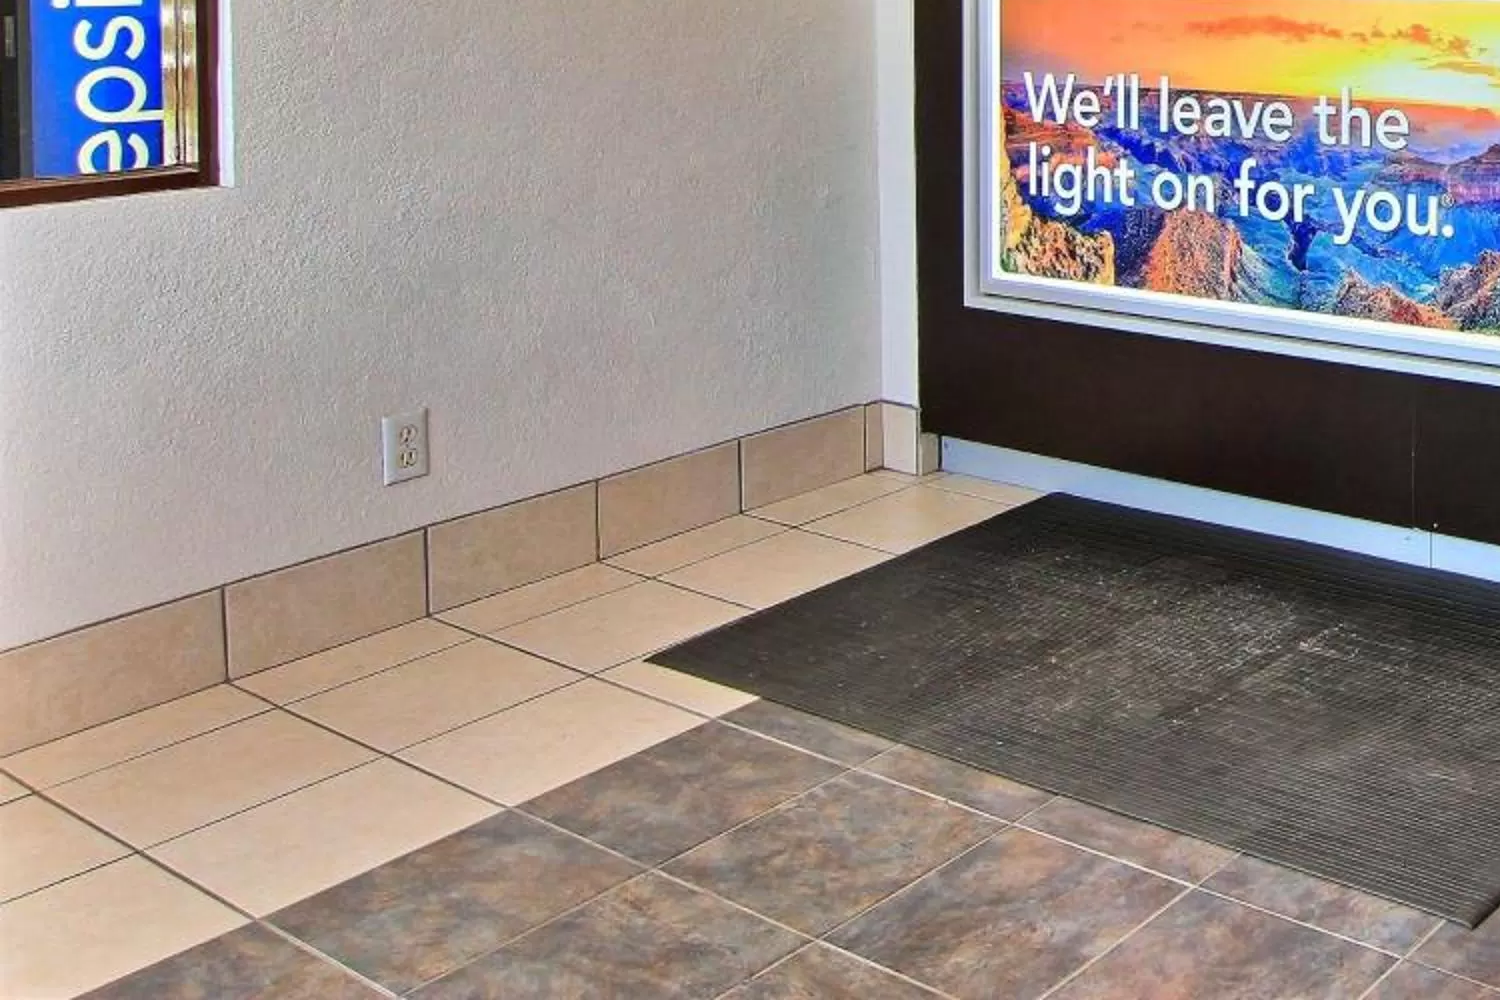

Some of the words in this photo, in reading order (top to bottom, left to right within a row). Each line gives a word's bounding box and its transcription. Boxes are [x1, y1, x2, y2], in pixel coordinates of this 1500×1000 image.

[1023, 71, 1140, 131] We'll
[1158, 75, 1294, 142] leave
[1312, 86, 1410, 151] the
[1027, 142, 1135, 217] light
[1151, 169, 1216, 213] on
[1233, 158, 1316, 223] for
[1332, 186, 1455, 246] you.
